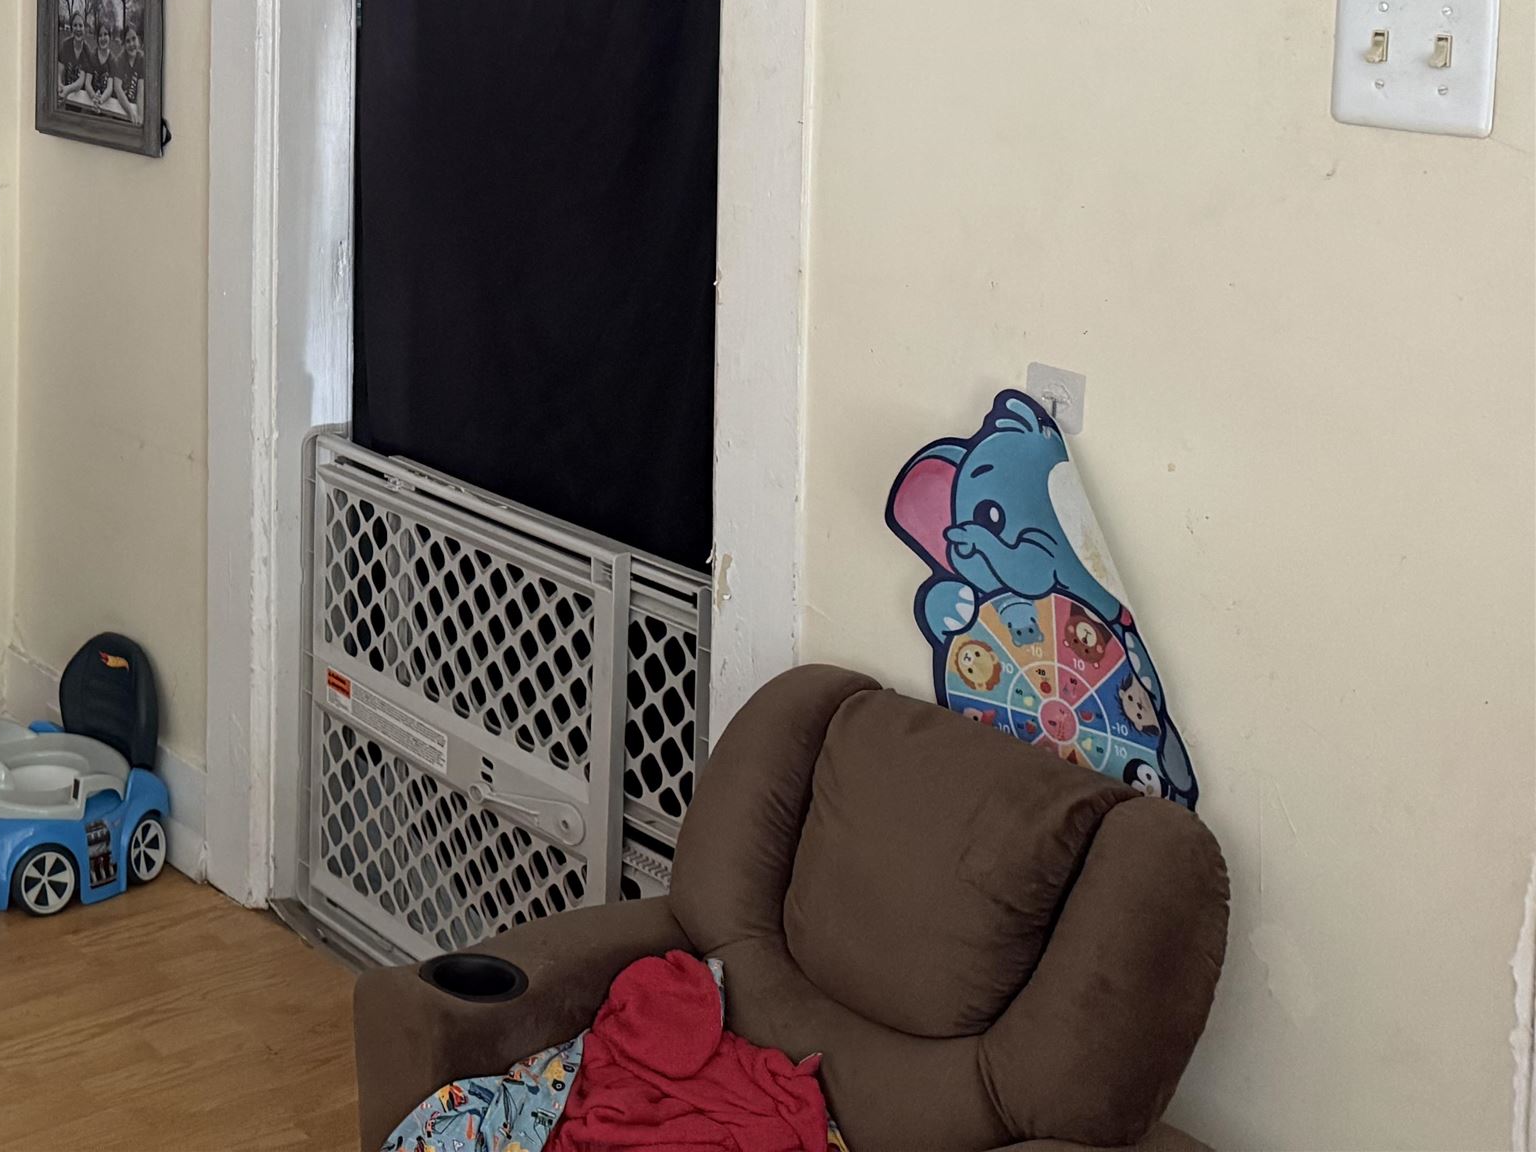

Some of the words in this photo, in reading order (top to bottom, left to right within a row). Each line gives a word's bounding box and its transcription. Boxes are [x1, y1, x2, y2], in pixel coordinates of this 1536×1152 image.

[1001, 661, 1014, 674] 10
[1072, 658, 1085, 671] 10
[1112, 721, 1129, 737] -10
[1115, 744, 1128, 758] 10
